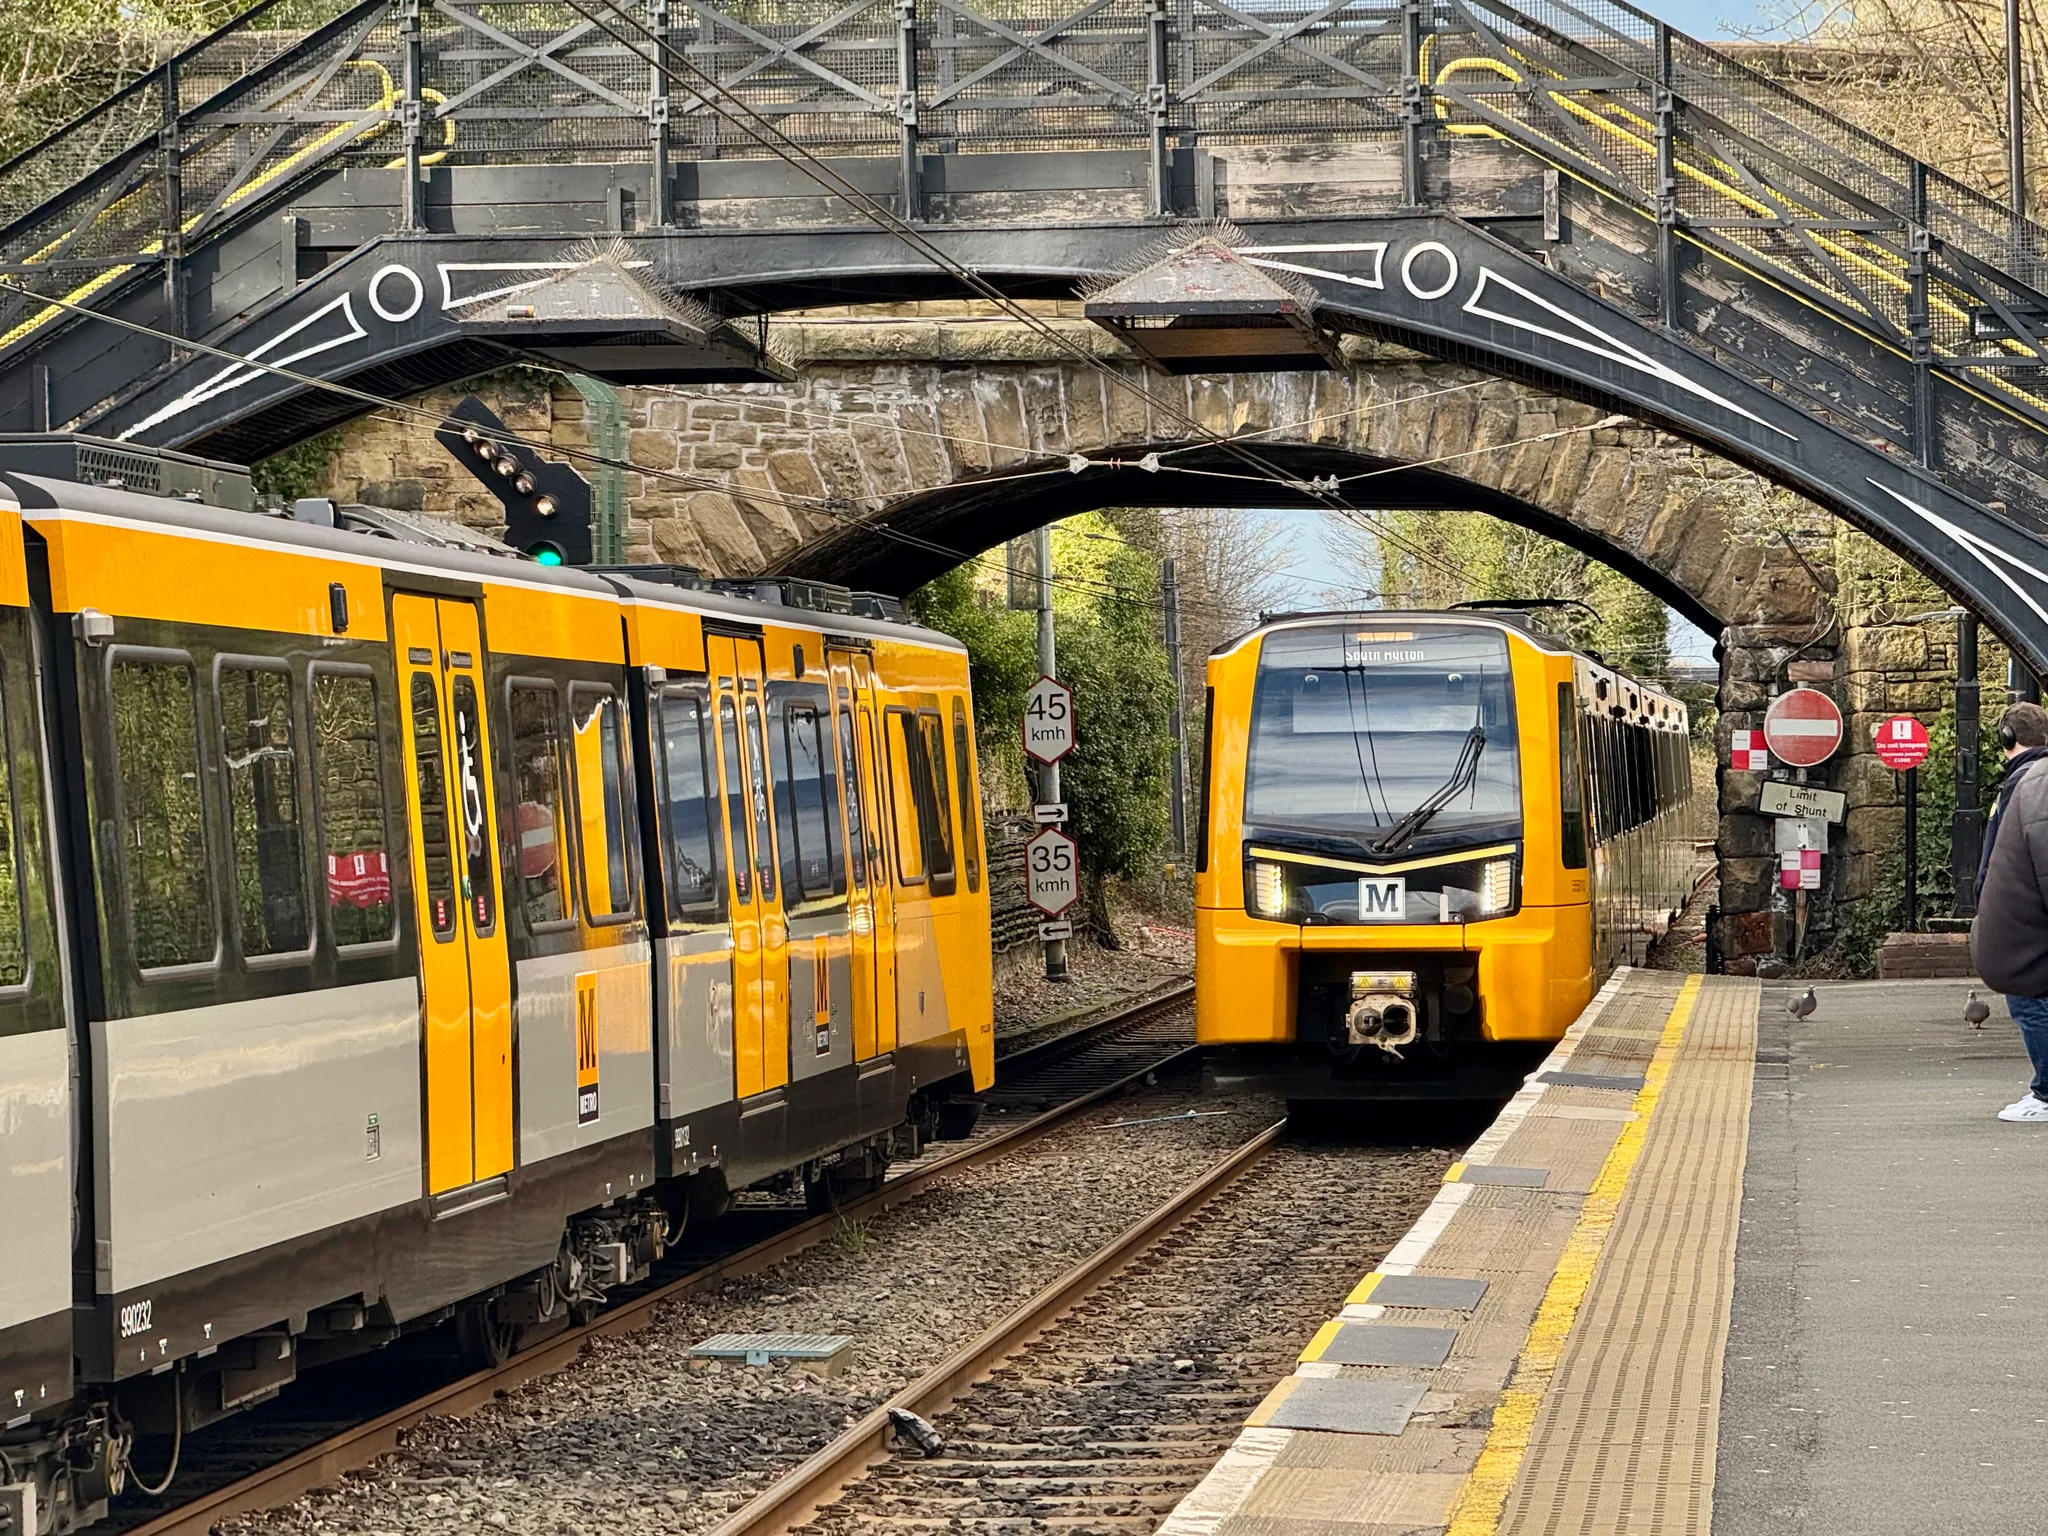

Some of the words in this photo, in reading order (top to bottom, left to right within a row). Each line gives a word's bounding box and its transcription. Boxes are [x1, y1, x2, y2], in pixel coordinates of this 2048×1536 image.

[1027, 693, 1066, 720] 45
[1031, 726, 1065, 741] kmh
[1789, 789, 1817, 801] Limit
[1776, 802, 1787, 811] of
[1794, 804, 1827, 817] Shunt
[1032, 845, 1071, 872] 35
[1035, 877, 1070, 893] kmh
[1366, 884, 1398, 912] M
[815, 948, 828, 1013] M
[578, 988, 596, 1071] M
[579, 1091, 597, 1115] METRO
[121, 1299, 152, 1338] 990232
